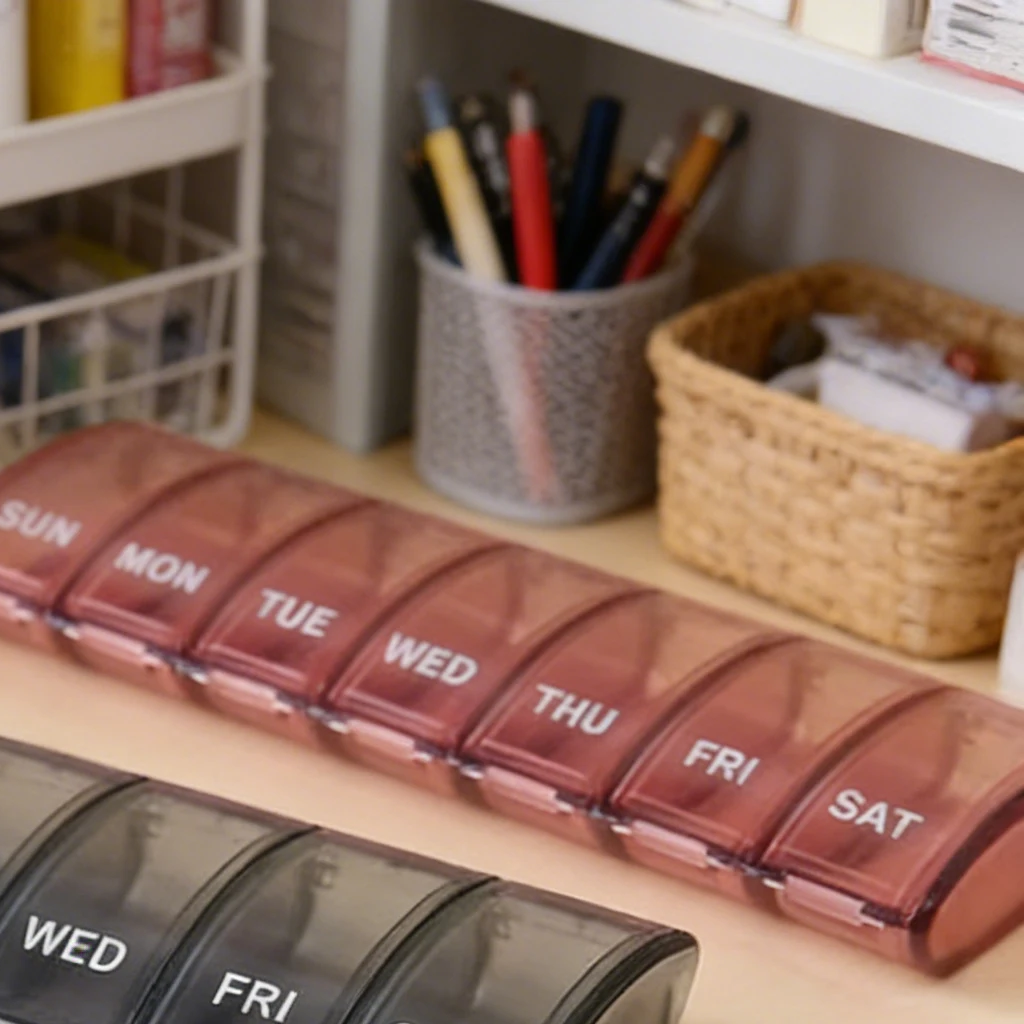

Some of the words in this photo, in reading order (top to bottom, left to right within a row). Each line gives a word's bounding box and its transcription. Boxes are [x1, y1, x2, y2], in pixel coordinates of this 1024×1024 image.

[113, 542, 210, 595] MON
[257, 588, 339, 637] TUE
[383, 632, 478, 686] WED
[532, 683, 620, 735] THU
[683, 738, 760, 786] FRI
[828, 788, 924, 840] SAT
[22, 915, 127, 973] WED
[212, 971, 298, 1024] FRI
